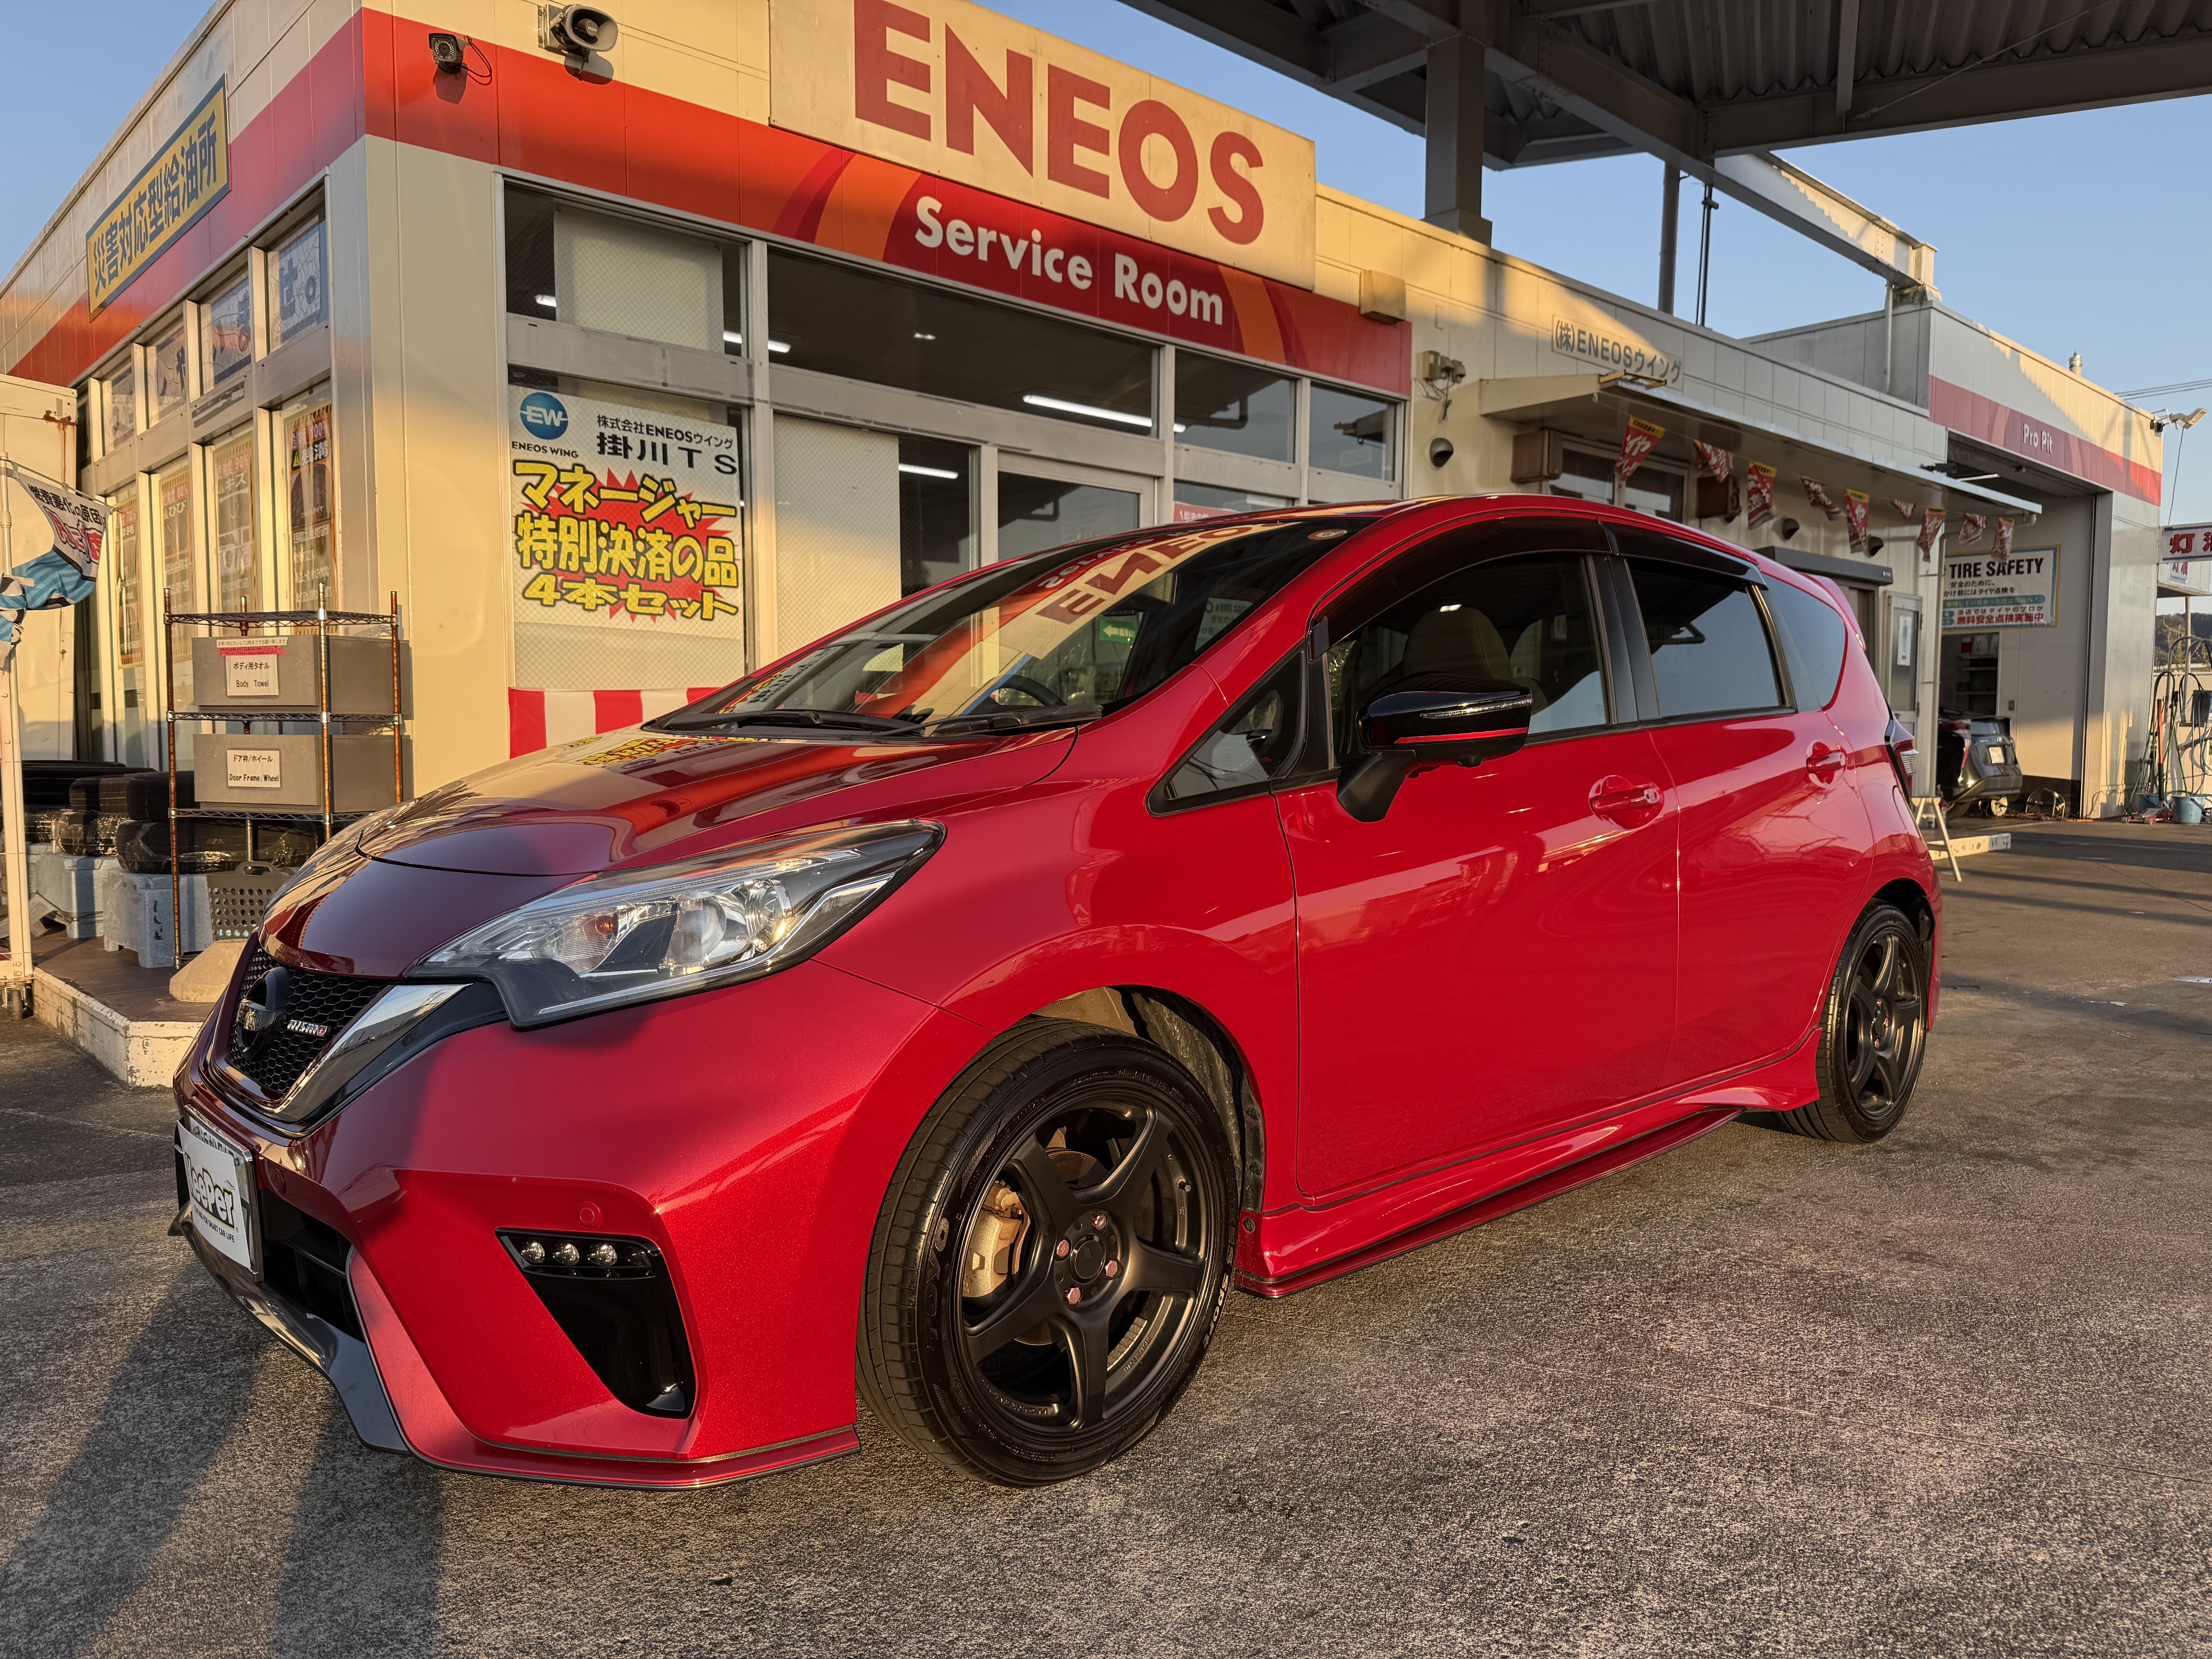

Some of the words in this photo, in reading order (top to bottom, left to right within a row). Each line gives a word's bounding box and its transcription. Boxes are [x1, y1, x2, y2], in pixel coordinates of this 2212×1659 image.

[854, 0, 1264, 245] ENEOS
[93, 108, 218, 297] 災害対応型給油所
[915, 196, 1093, 291] Service
[1114, 253, 1223, 326] Room
[596, 414, 733, 449] 株式会社ENEOSウイング
[2023, 423, 2038, 448] Pro
[2041, 430, 2053, 454] Pit
[511, 441, 548, 453] ENEOS
[549, 447, 579, 459] WING
[225, 469, 247, 491] キズ
[513, 459, 737, 529] マネージャー
[168, 499, 187, 517] ひび
[515, 512, 739, 588] 特別決済の品
[1949, 562, 1982, 579] TIRE
[1986, 558, 2044, 577] SAFETY
[522, 573, 739, 620] 4本セット
[1957, 612, 2044, 625] 無料安全点検実施中
[233, 661, 270, 670] ボディ用タオル
[236, 680, 249, 688] Body
[234, 754, 273, 763] ドア枠/ホイール
[243, 774, 279, 782] Frame/Wheel
[209, 1219, 218, 1233] SMART
[226, 1232, 235, 1243] LIFE
